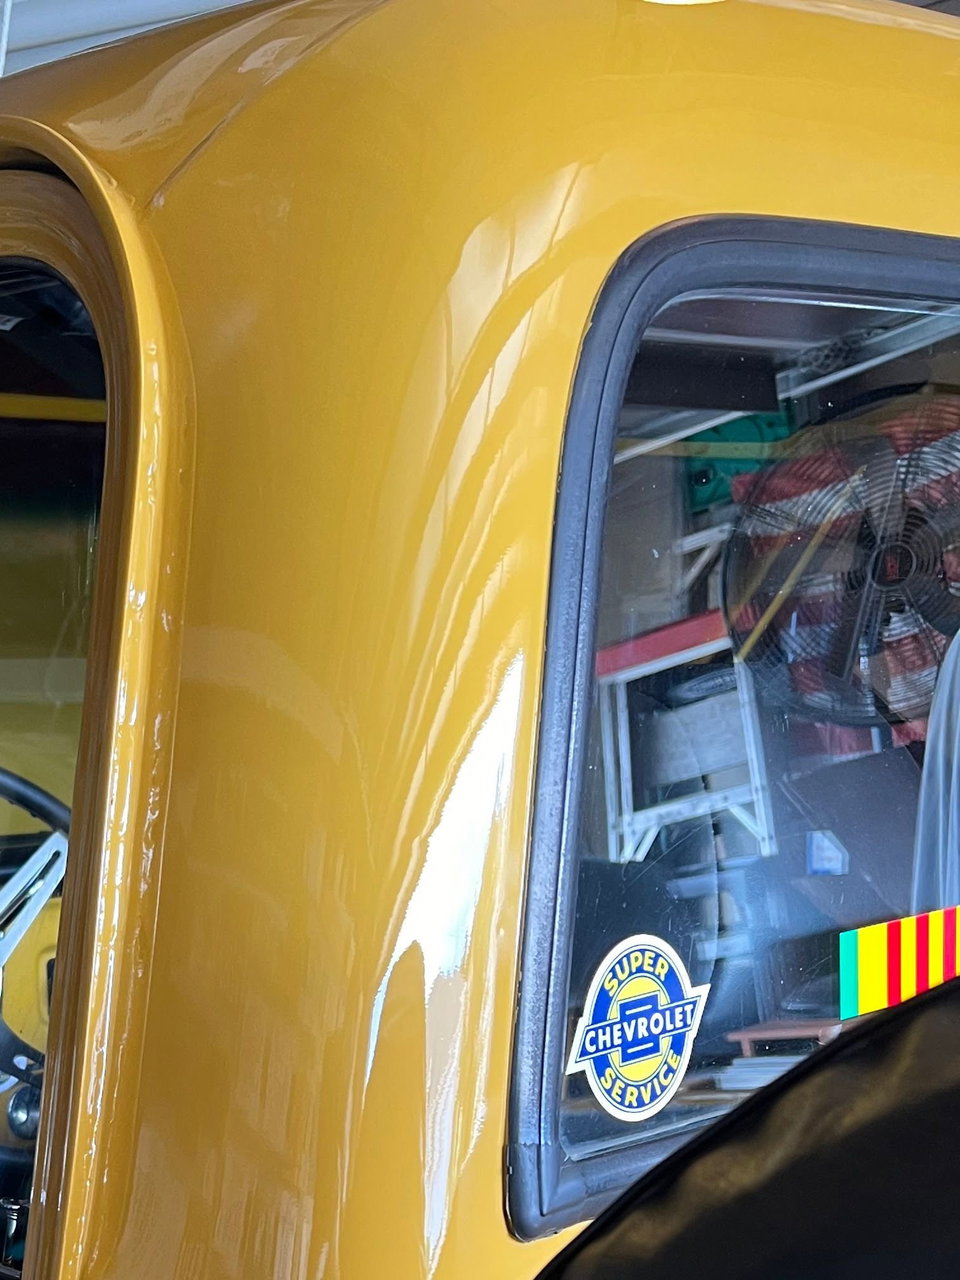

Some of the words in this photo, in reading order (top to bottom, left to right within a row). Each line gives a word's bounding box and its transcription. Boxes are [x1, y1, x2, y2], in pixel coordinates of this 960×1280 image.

[603, 950, 669, 997] SUPER
[584, 1004, 694, 1053] CHEVROLET
[601, 1049, 681, 1107] SERVICE
